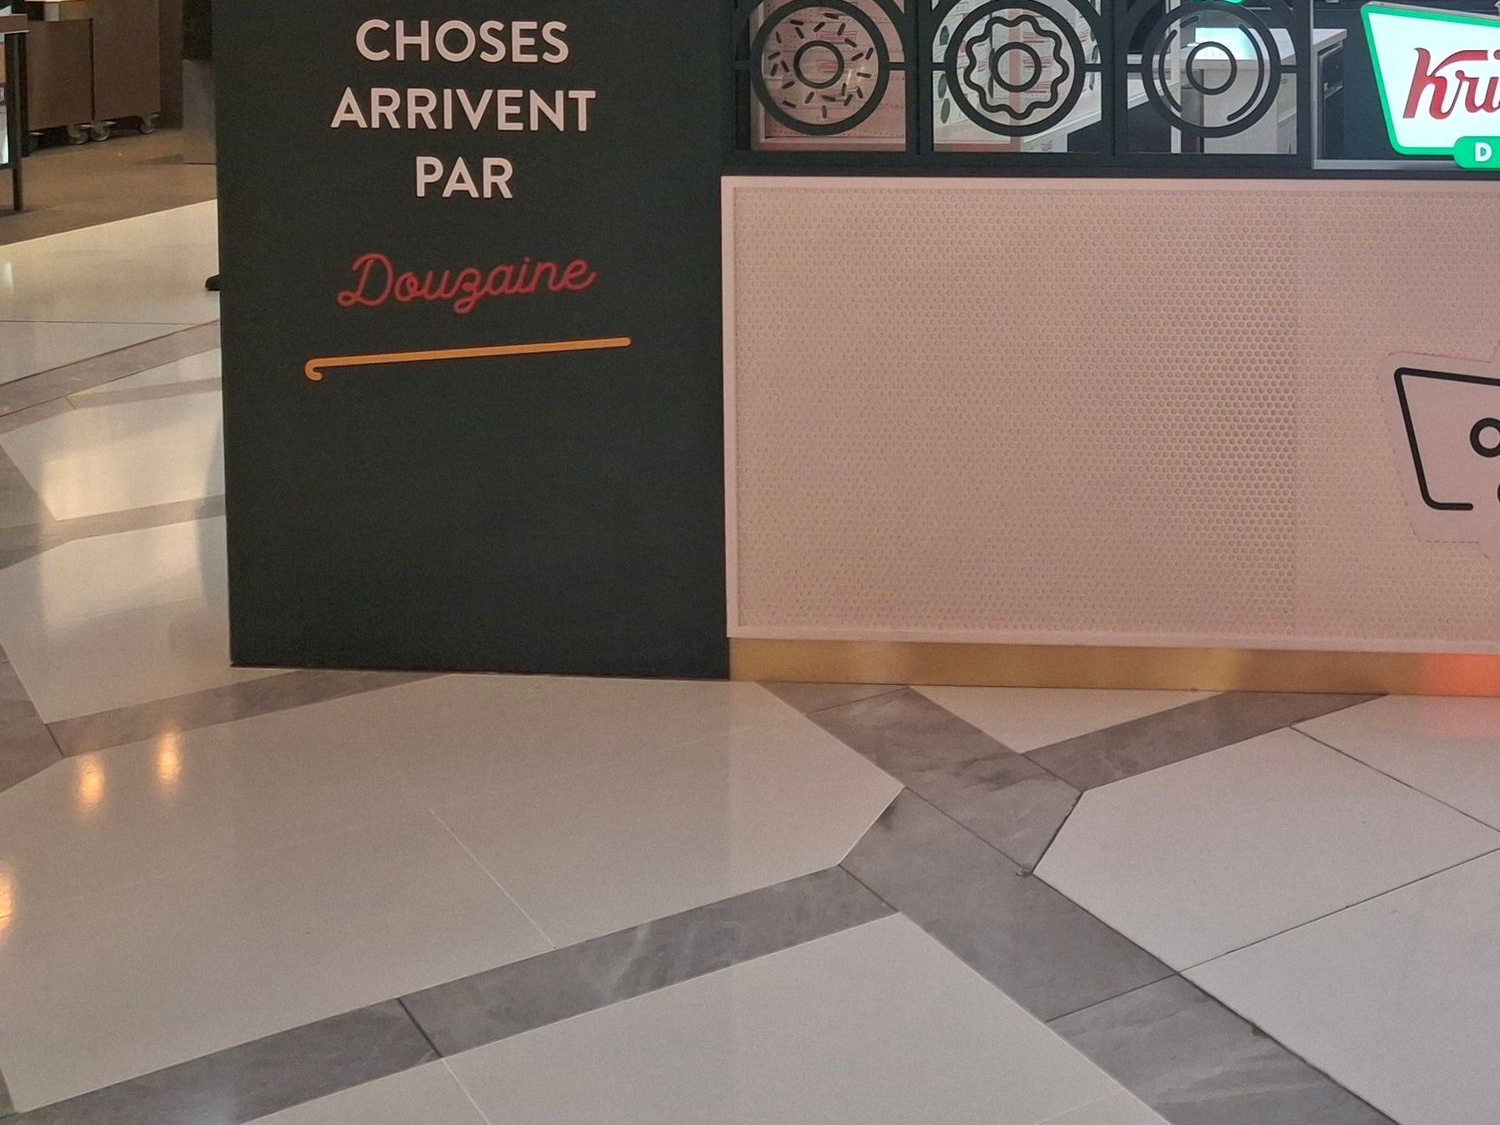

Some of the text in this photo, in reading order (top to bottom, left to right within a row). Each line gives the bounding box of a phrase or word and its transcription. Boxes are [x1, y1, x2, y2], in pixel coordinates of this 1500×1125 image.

[356, 19, 569, 63] CHOSES
[330, 87, 597, 132] ARRIVENT
[415, 156, 513, 199] PAR
[336, 252, 597, 314] Douzaine
